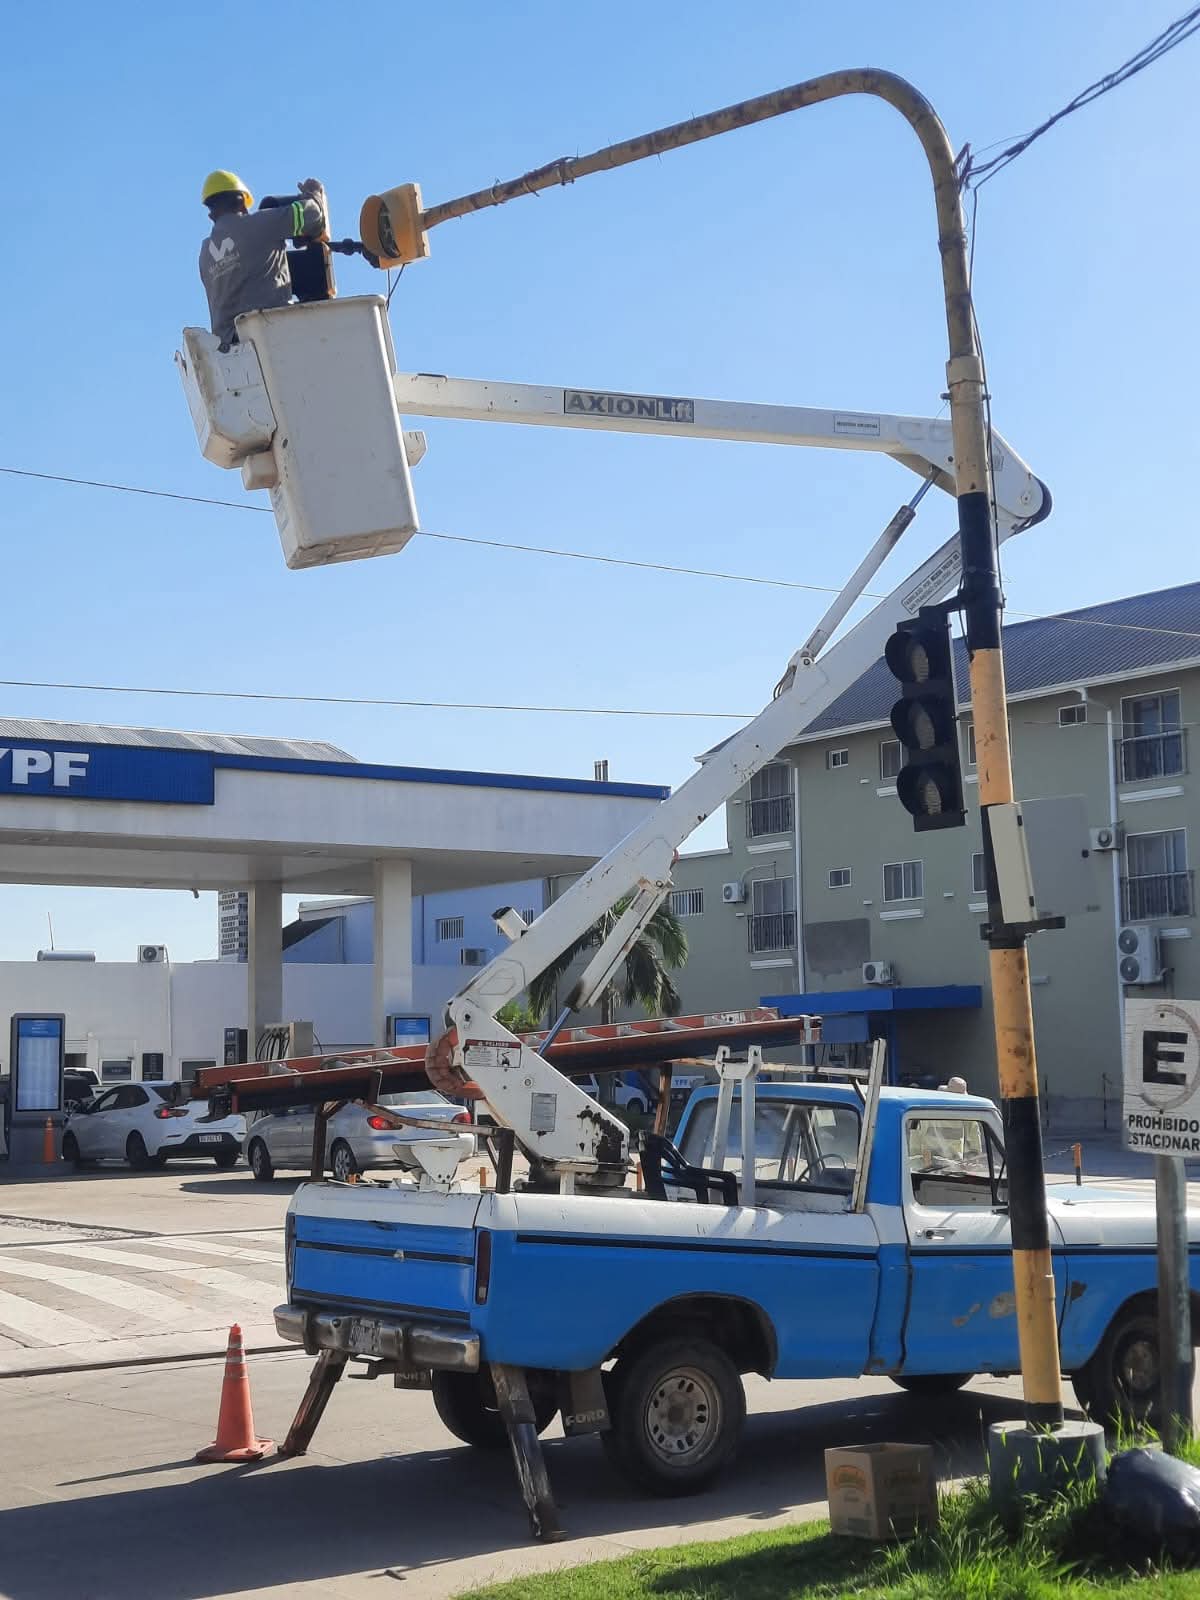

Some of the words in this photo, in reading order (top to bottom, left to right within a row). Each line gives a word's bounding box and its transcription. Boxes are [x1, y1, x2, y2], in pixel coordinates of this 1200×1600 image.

[0, 748, 90, 786] PF
[1143, 1030, 1188, 1086] E
[1128, 1114, 1200, 1133] PROHIBIDO
[565, 1409, 606, 1426] FORD
